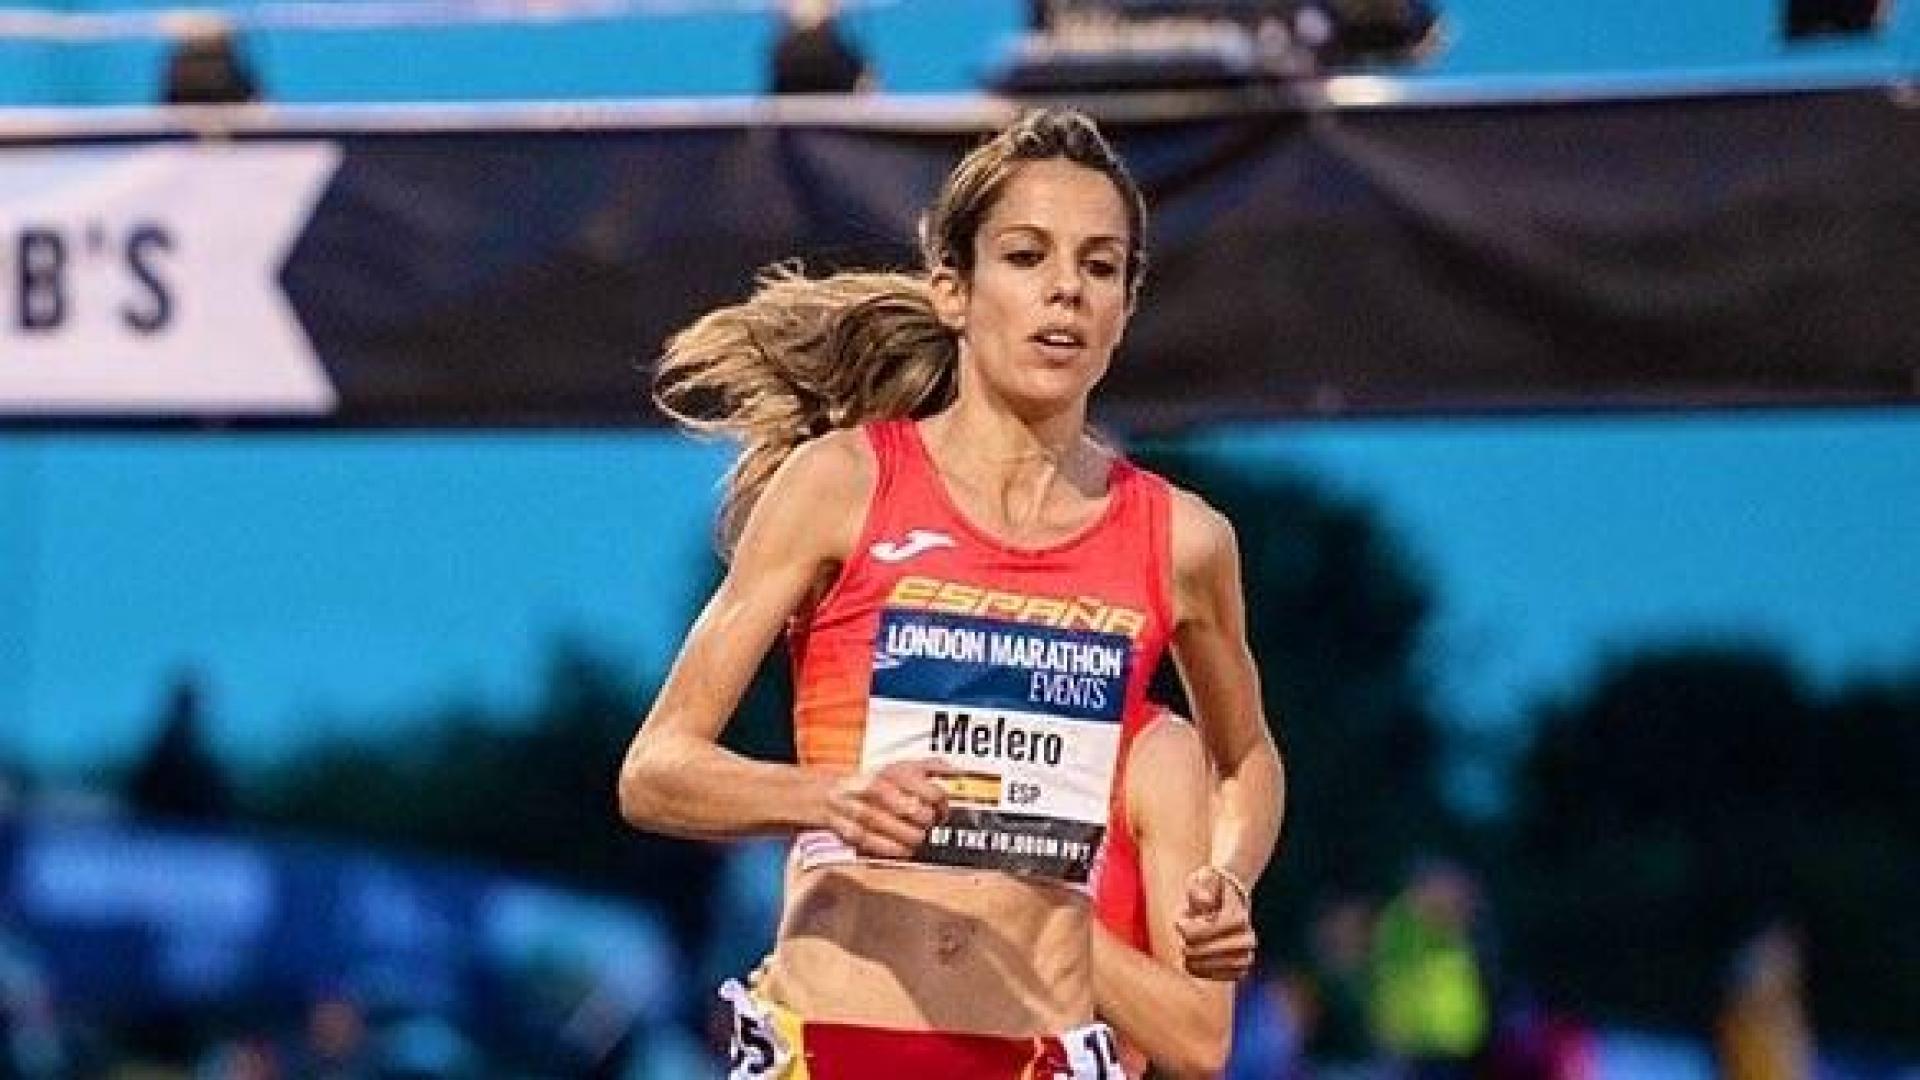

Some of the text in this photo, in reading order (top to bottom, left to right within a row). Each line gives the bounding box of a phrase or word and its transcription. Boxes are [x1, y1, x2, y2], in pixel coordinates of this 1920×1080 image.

[888, 576, 1145, 637] ESPAÑA
[887, 626, 1121, 678] LONDON MARATHON
[1030, 671, 1108, 709] EVENTS
[930, 711, 1063, 765] Melero
[1007, 783, 1042, 804] ESP
[957, 829, 987, 850] THE
